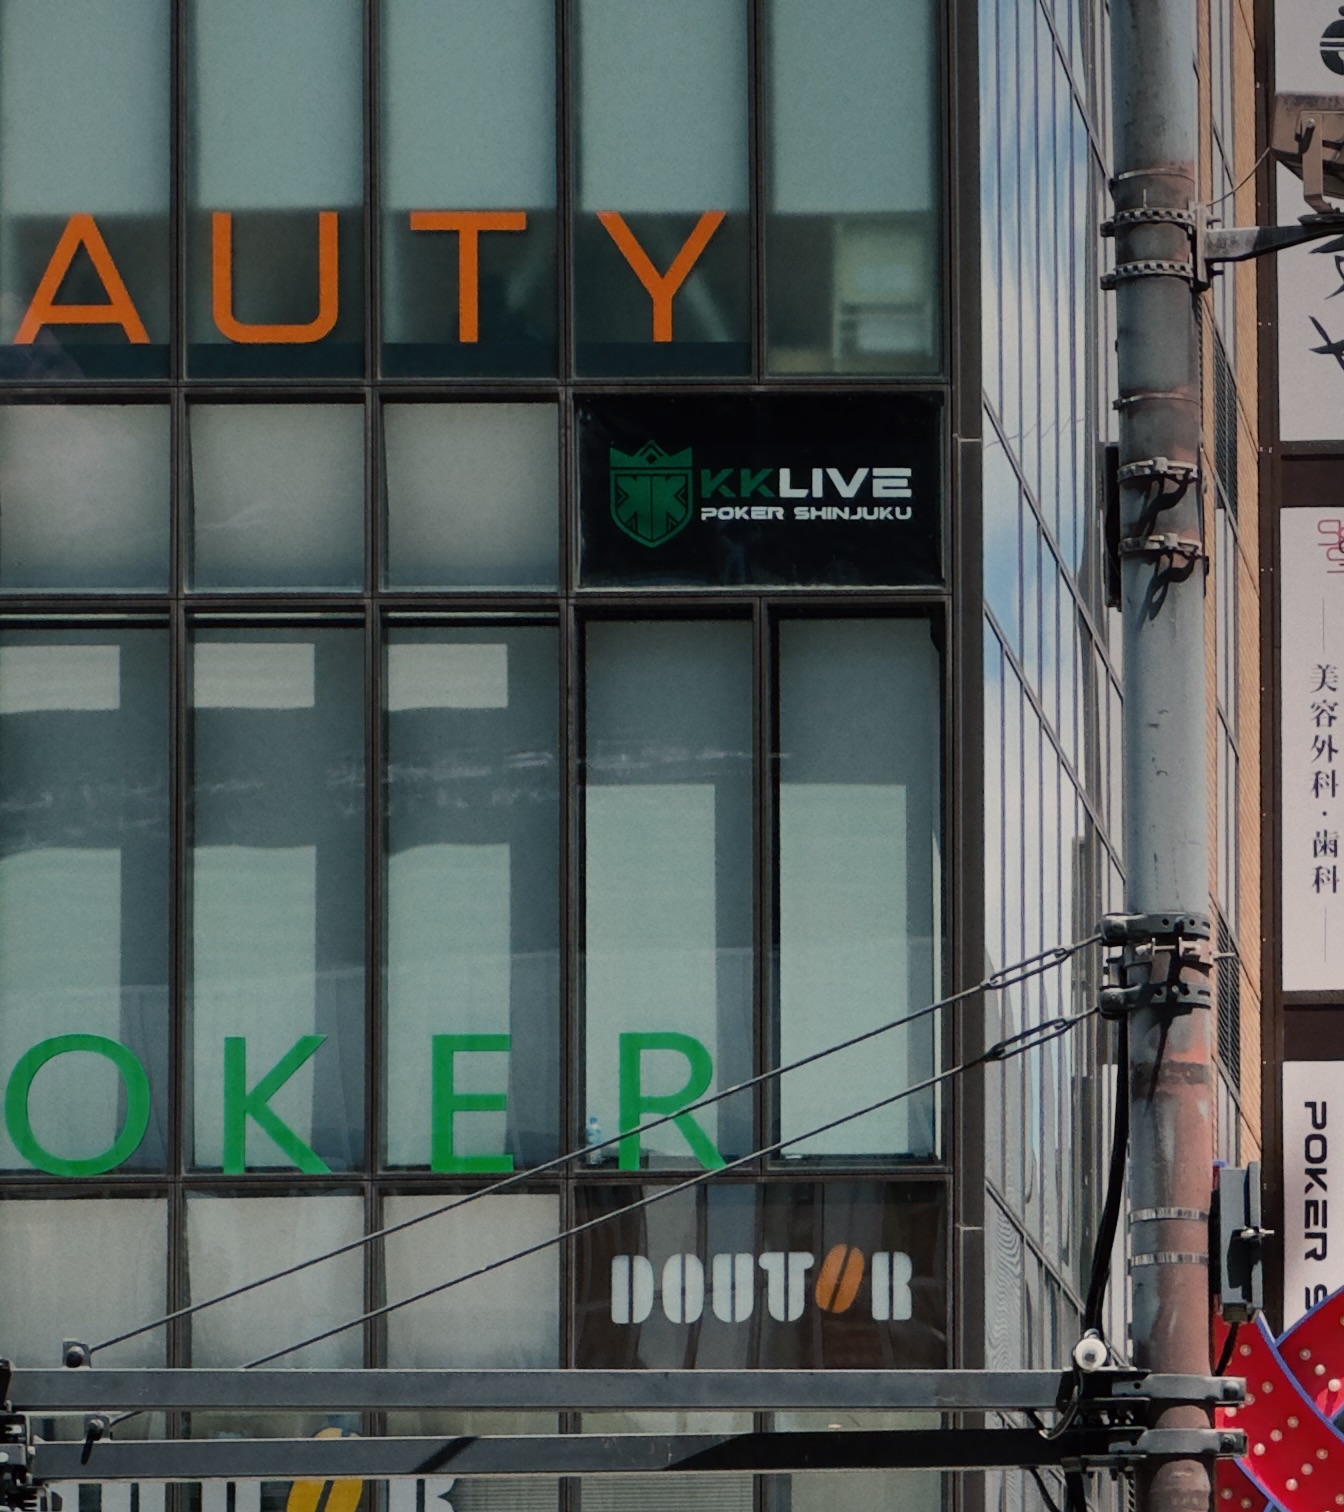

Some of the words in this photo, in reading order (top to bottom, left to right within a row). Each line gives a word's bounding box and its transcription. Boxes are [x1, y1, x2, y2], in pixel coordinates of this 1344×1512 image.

[13, 210, 727, 344] AUTY
[701, 467, 913, 499] KKLIVE
[701, 507, 784, 521] POKER
[794, 507, 913, 521] SHINJUKU
[1309, 663, 1340, 894] 美容外科・歯科
[4, 1032, 727, 1177] OKER
[1304, 1102, 1327, 1261] POKER
[611, 1244, 913, 1324] DOUTOR
